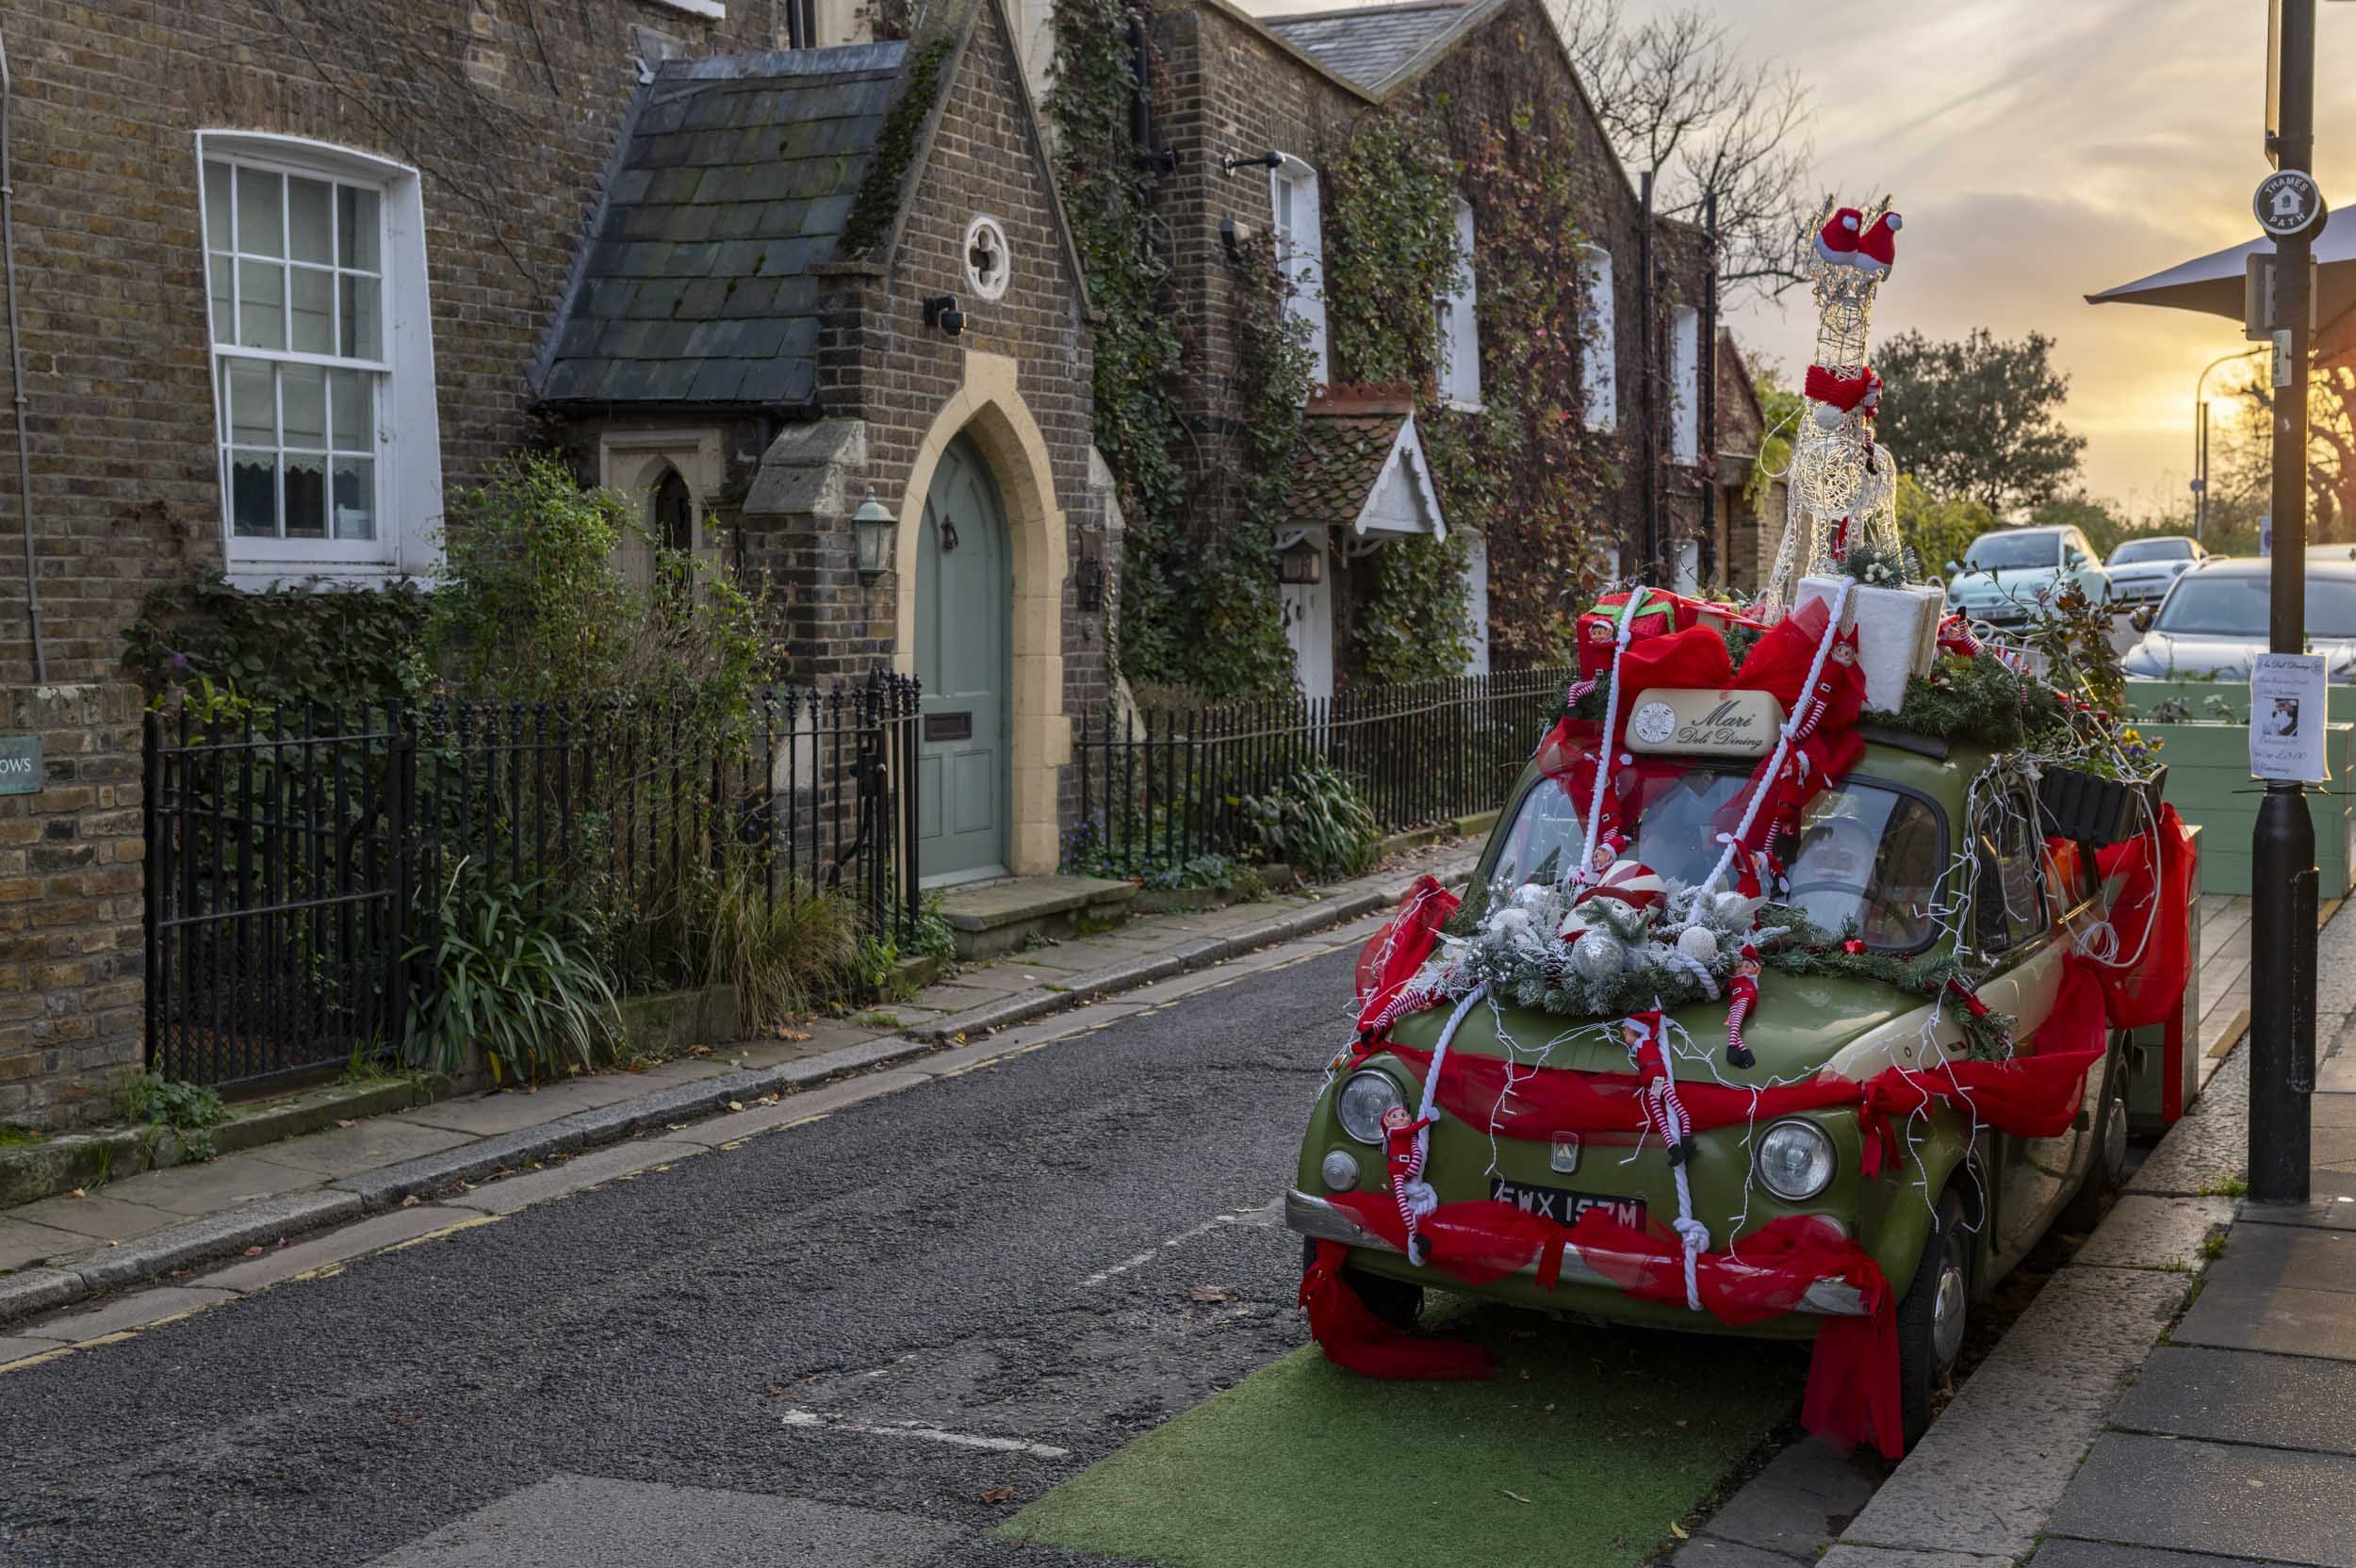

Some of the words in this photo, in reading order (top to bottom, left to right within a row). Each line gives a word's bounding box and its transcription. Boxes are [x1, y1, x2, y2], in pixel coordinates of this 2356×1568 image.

[2265, 176, 2309, 194] THAMES
[2269, 214, 2305, 227] PATH
[1692, 700, 1756, 727] Mari
[1677, 727, 1713, 744] Deli
[1712, 727, 1763, 751] Dining
